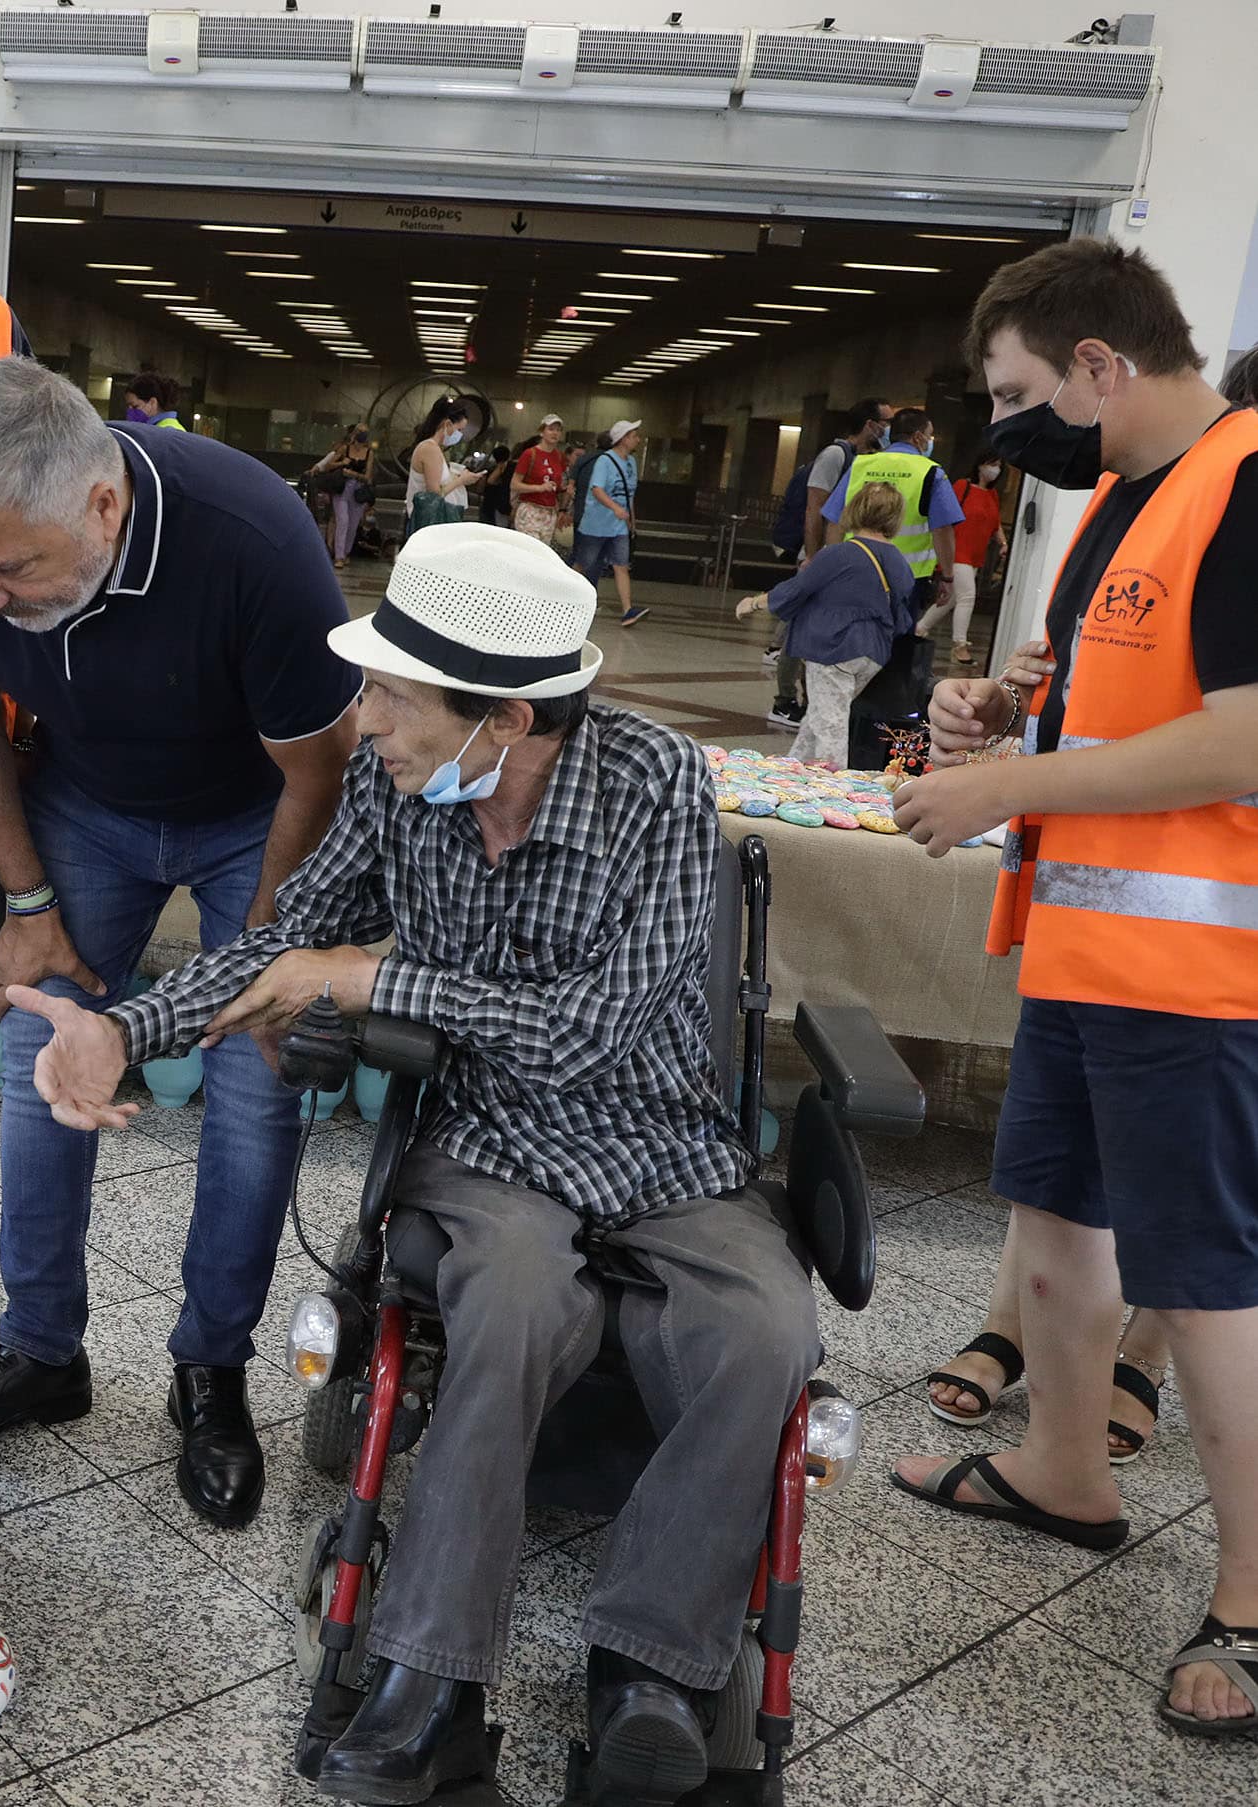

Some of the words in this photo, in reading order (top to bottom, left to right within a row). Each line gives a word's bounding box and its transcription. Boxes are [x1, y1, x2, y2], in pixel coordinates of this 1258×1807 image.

[385, 204, 462, 222] Αποβάθρες
[400, 220, 444, 231] Platforms
[1082, 634, 1158, 652] www.keana.gr
